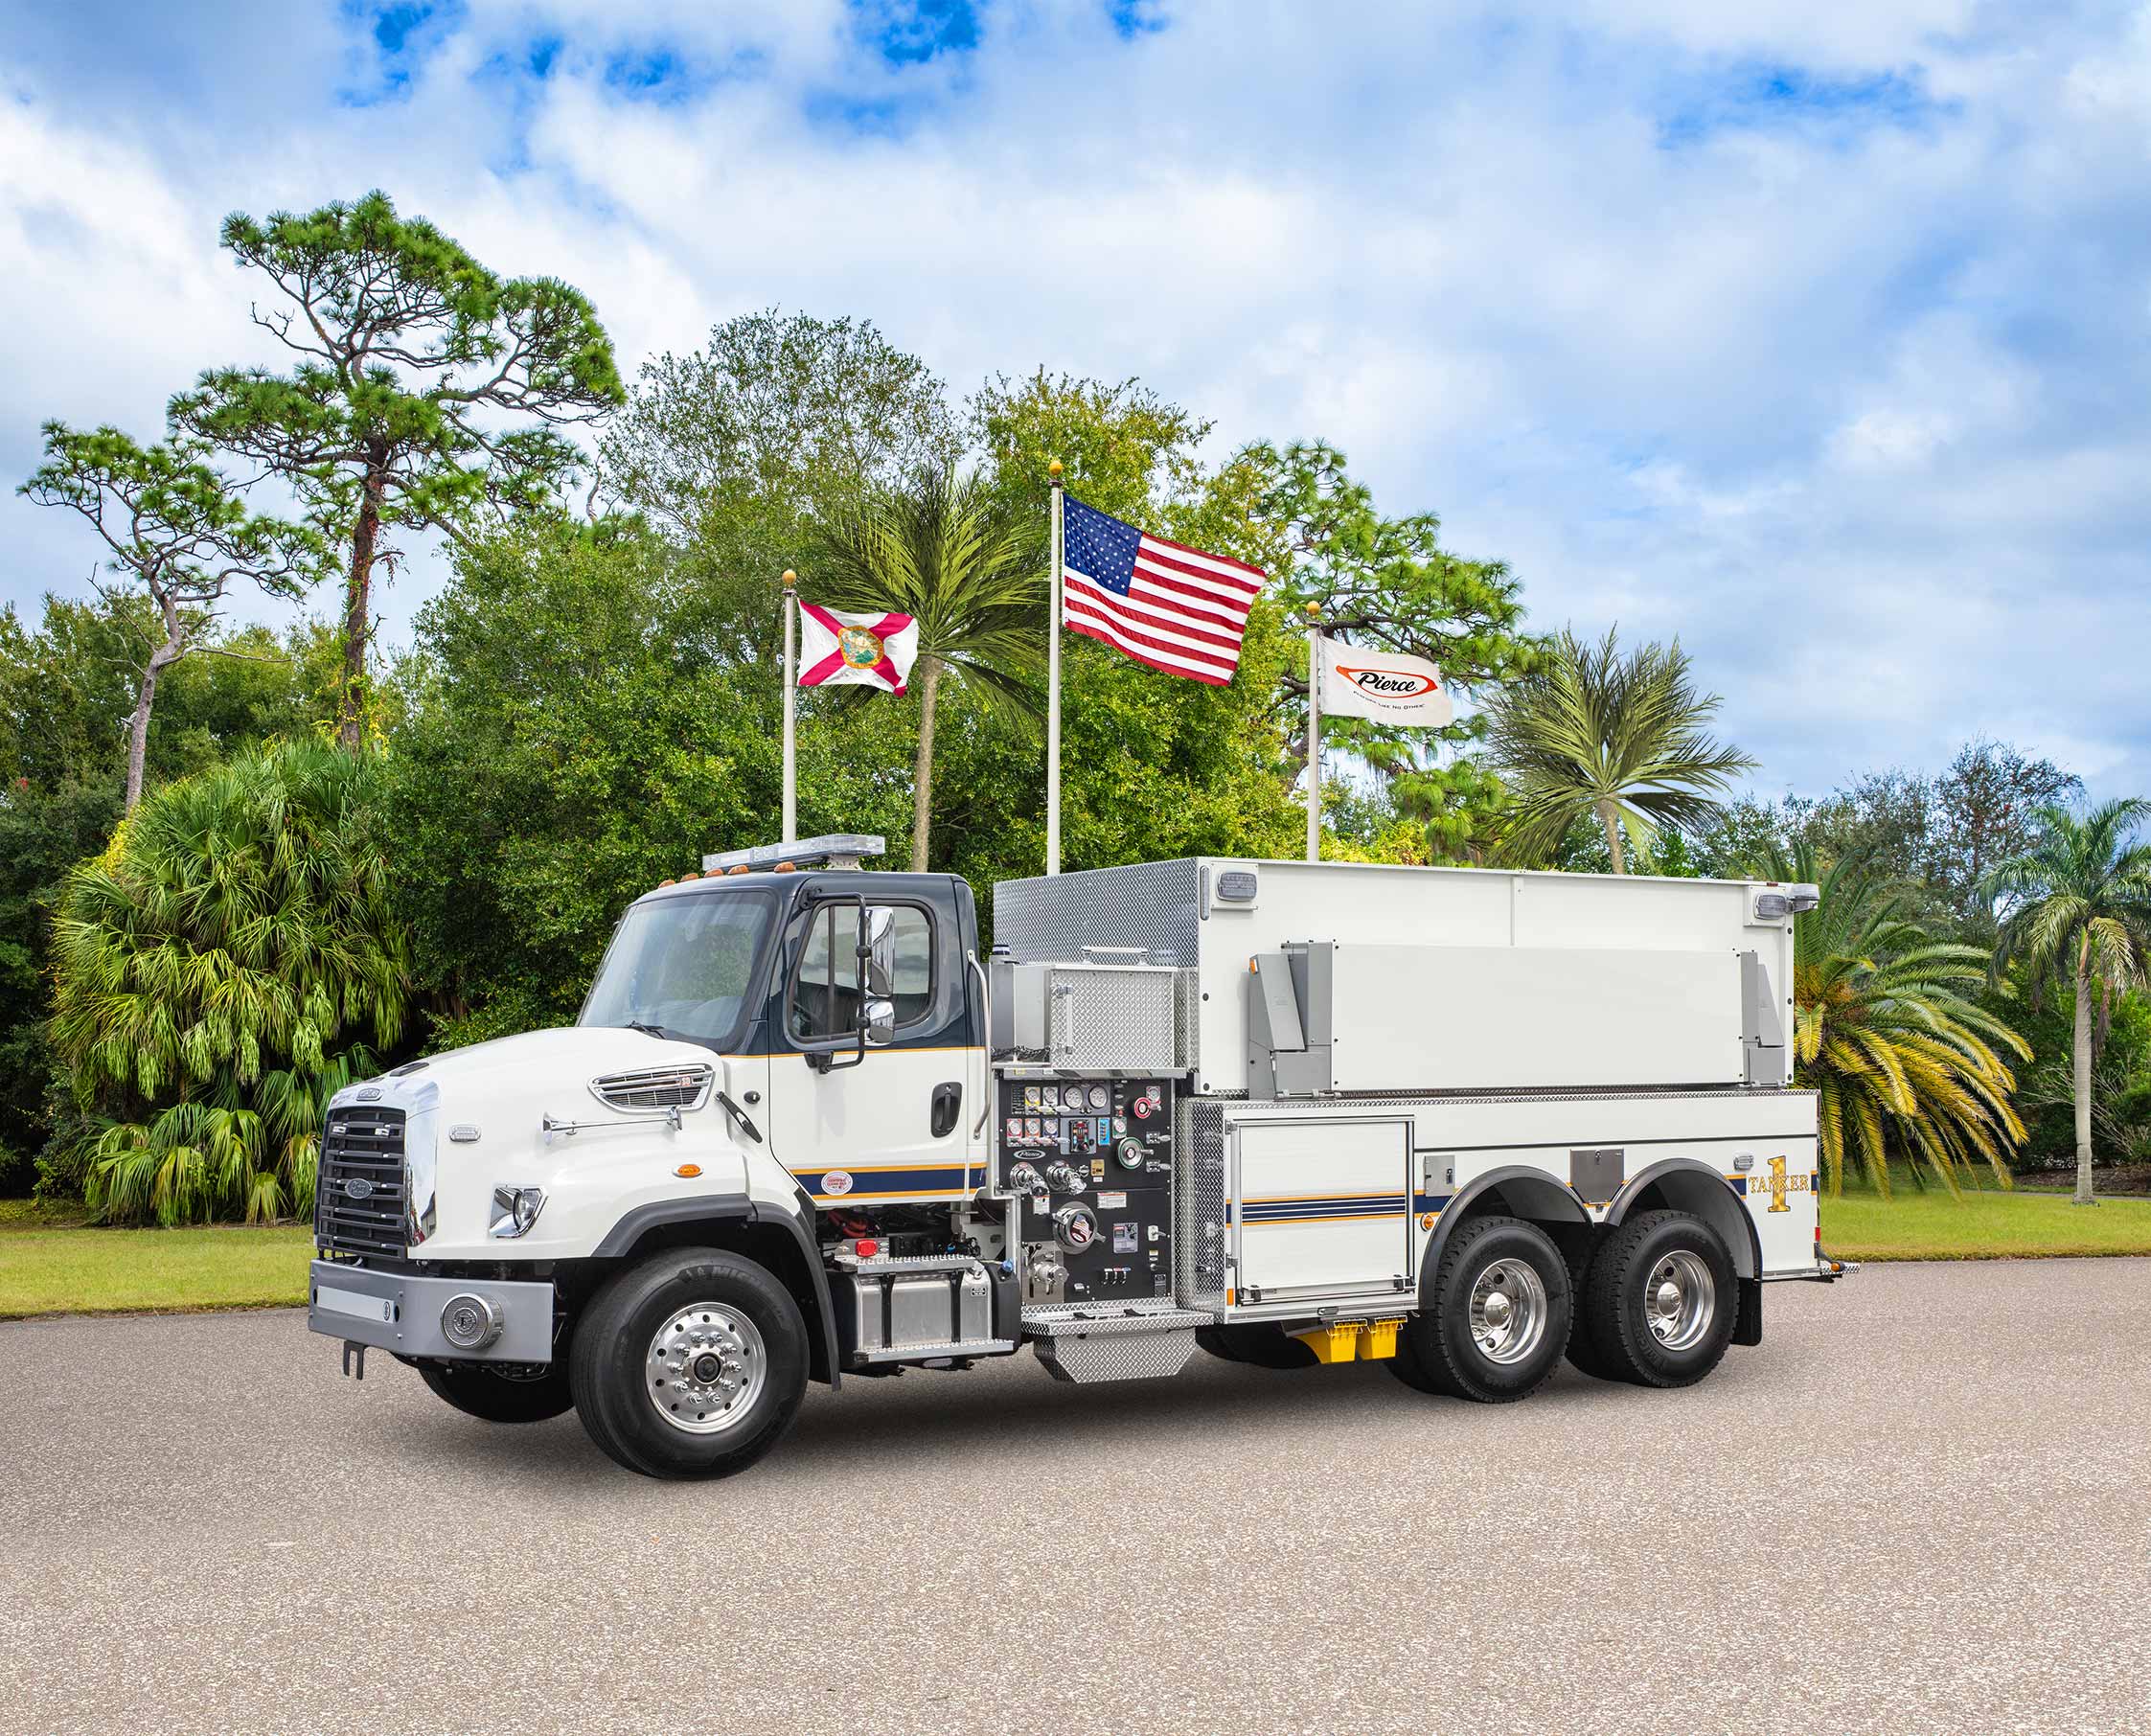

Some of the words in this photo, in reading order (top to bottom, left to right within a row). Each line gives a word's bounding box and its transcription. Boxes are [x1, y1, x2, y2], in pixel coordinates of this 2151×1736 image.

[1358, 673, 1416, 692] Pierce
[1749, 1175, 1809, 1194] TANKER
[1768, 1155, 1791, 1213] 1
